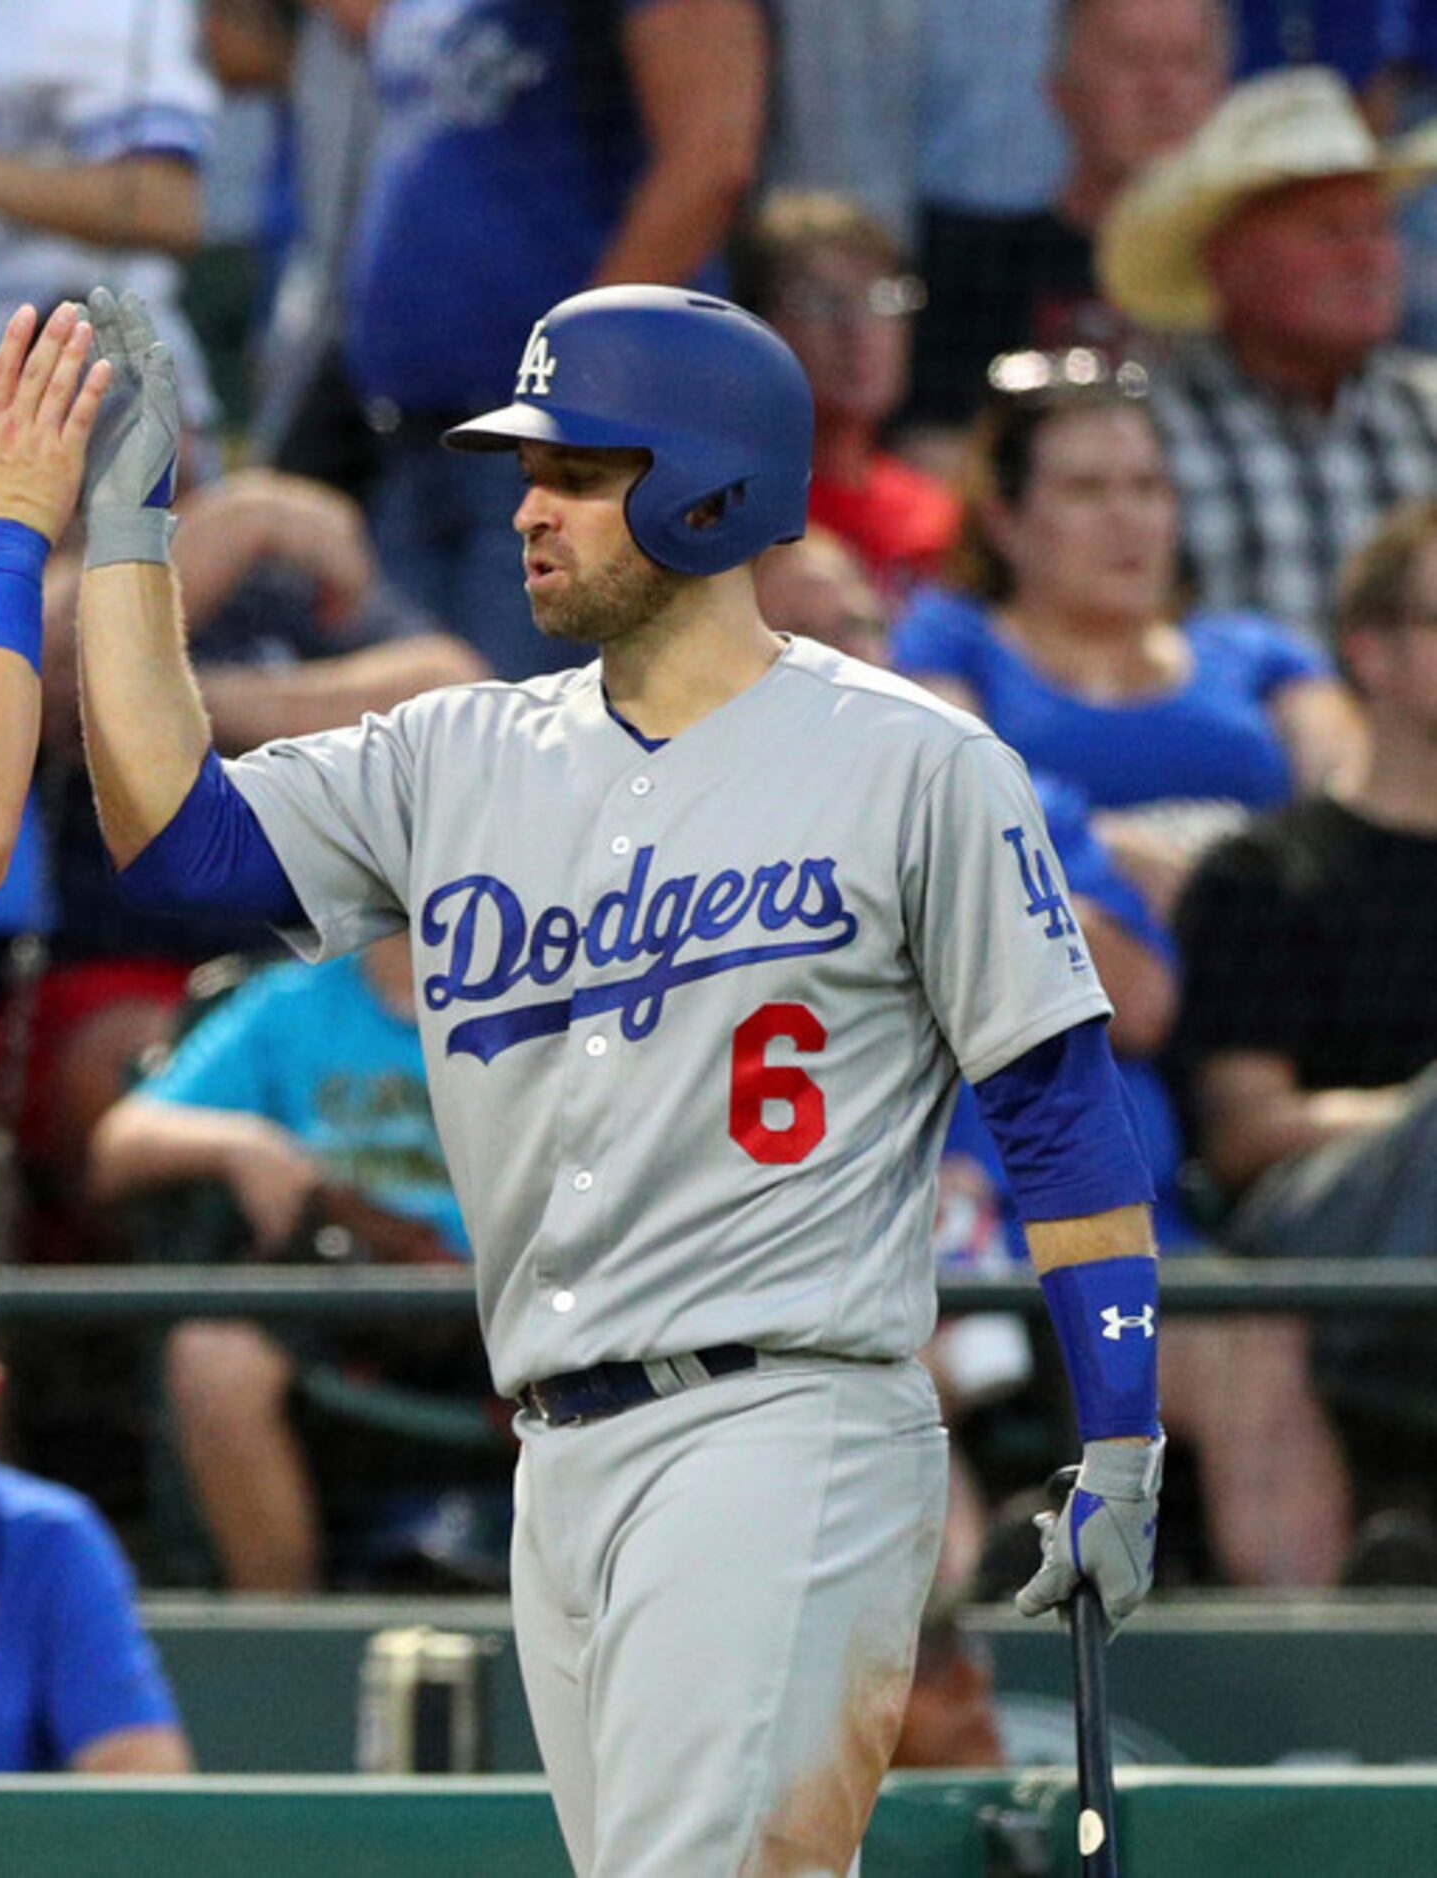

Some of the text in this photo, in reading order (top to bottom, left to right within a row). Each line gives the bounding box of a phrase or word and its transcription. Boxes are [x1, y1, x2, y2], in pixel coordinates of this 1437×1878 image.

[515, 320, 556, 394] LA
[1002, 825, 1077, 939] LA
[421, 845, 858, 1066] Dodgers
[729, 1003, 828, 1165] 6
